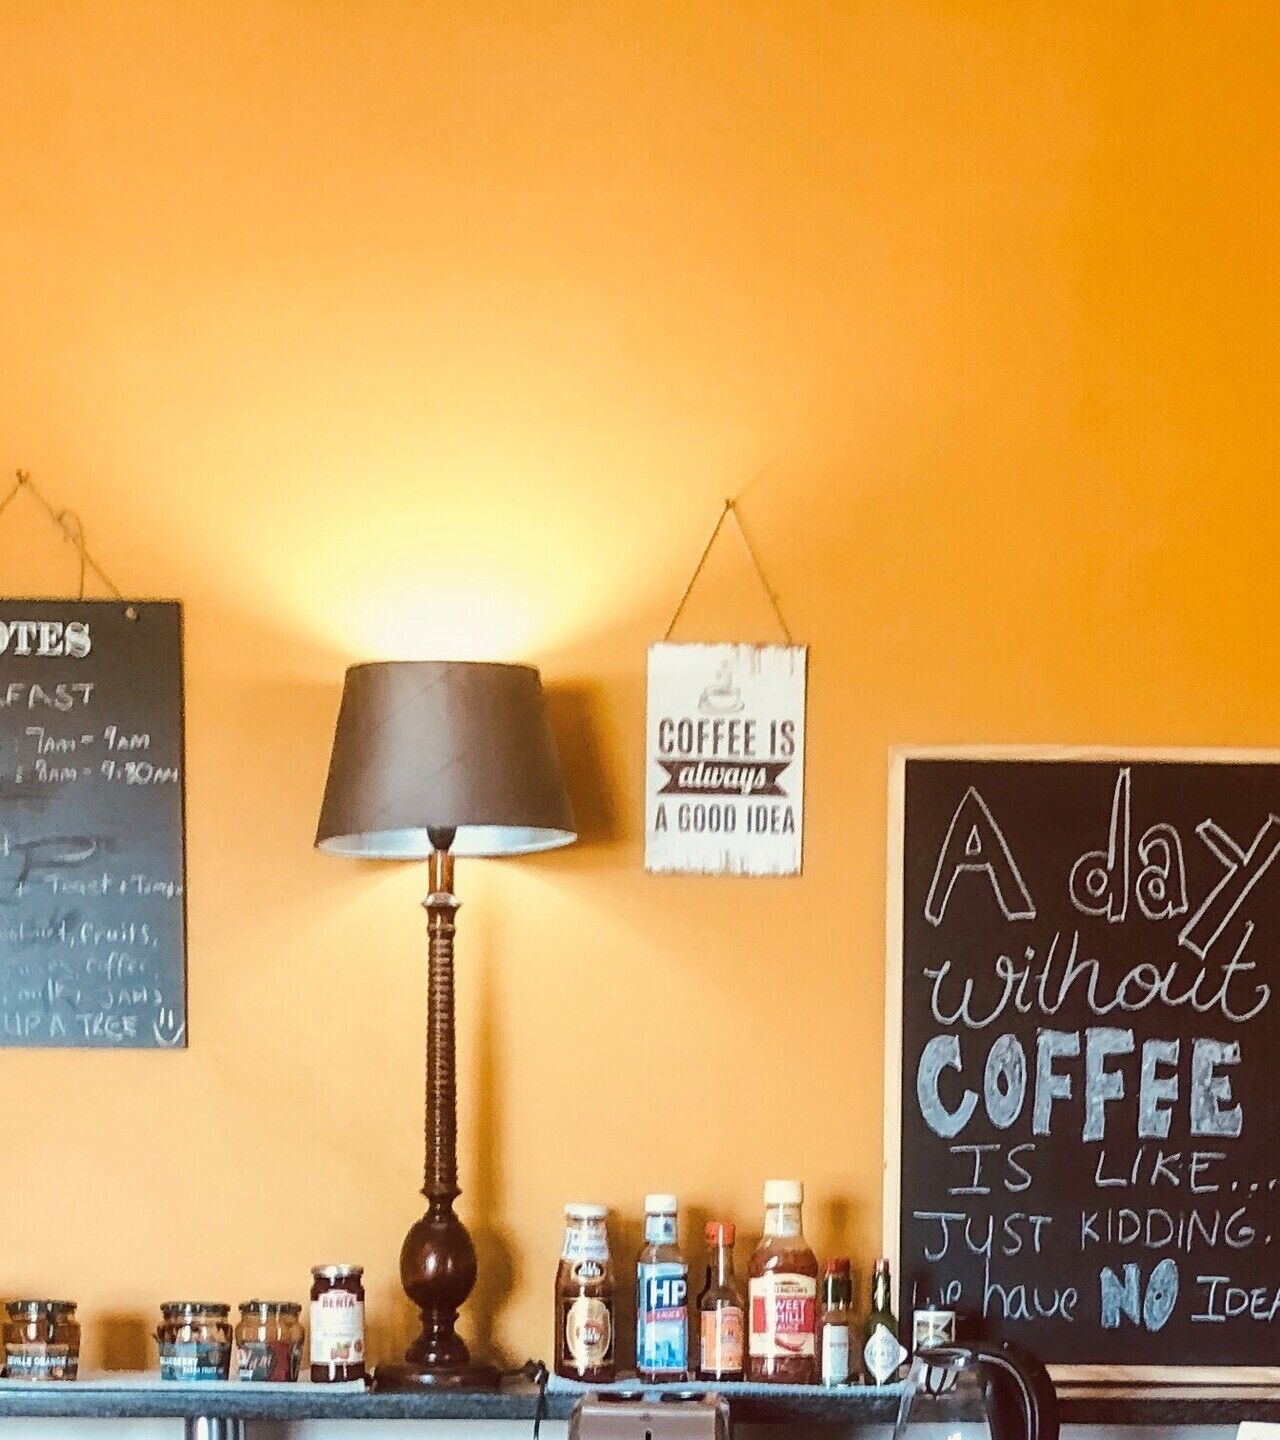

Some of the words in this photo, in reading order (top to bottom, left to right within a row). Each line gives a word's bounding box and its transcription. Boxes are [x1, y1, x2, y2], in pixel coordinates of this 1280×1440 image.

[658, 717, 757, 757] COFFEE
[769, 719, 796, 757] IS
[677, 761, 768, 796] always
[654, 803, 668, 833] A
[678, 803, 737, 833] GOOD
[747, 803, 796, 834] IDEA
[924, 786, 1036, 926] A
[923, 919, 1270, 1029] without
[916, 1028, 1243, 1142] COFFEE
[948, 1143, 1036, 1195] IS
[913, 1210, 1053, 1262] JUST
[1081, 1207, 1272, 1252] KIDDING.
[649, 1279, 687, 1307] HP
[983, 1257, 1079, 1323] have
[1100, 1258, 1179, 1332] NO
